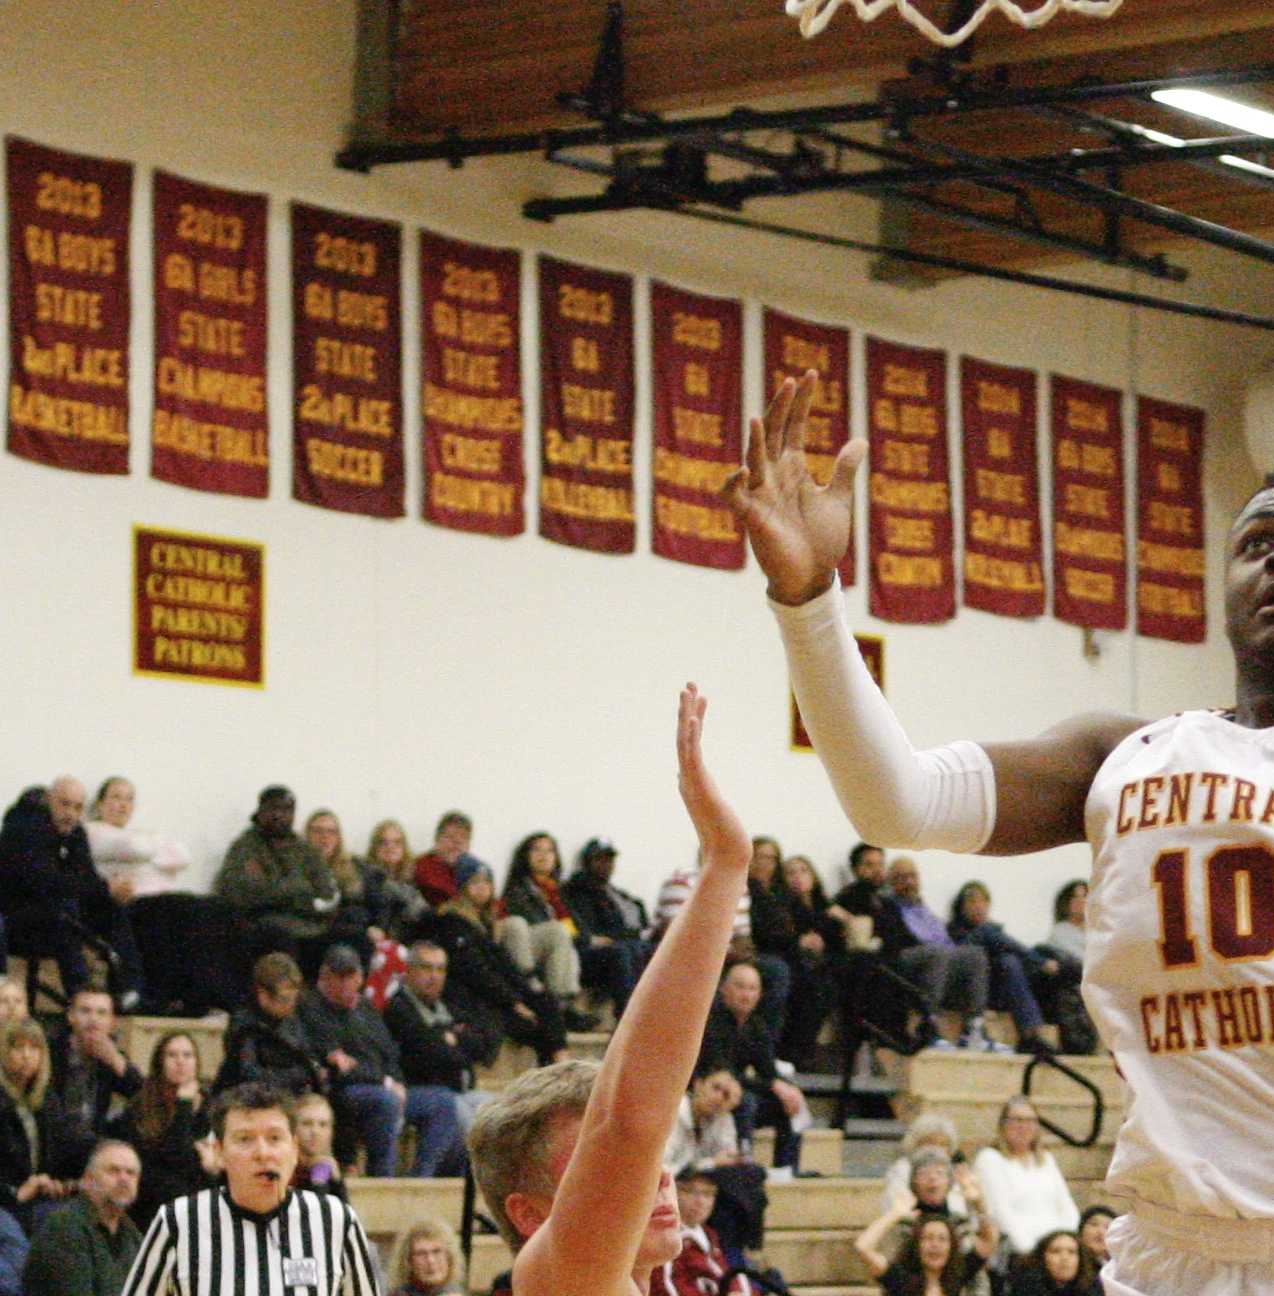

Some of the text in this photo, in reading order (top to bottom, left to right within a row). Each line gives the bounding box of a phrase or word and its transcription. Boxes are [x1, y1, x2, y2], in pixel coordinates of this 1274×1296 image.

[36, 282, 102, 330] STATE
[178, 310, 244, 356] STATE
[56, 341, 125, 387] PLACE
